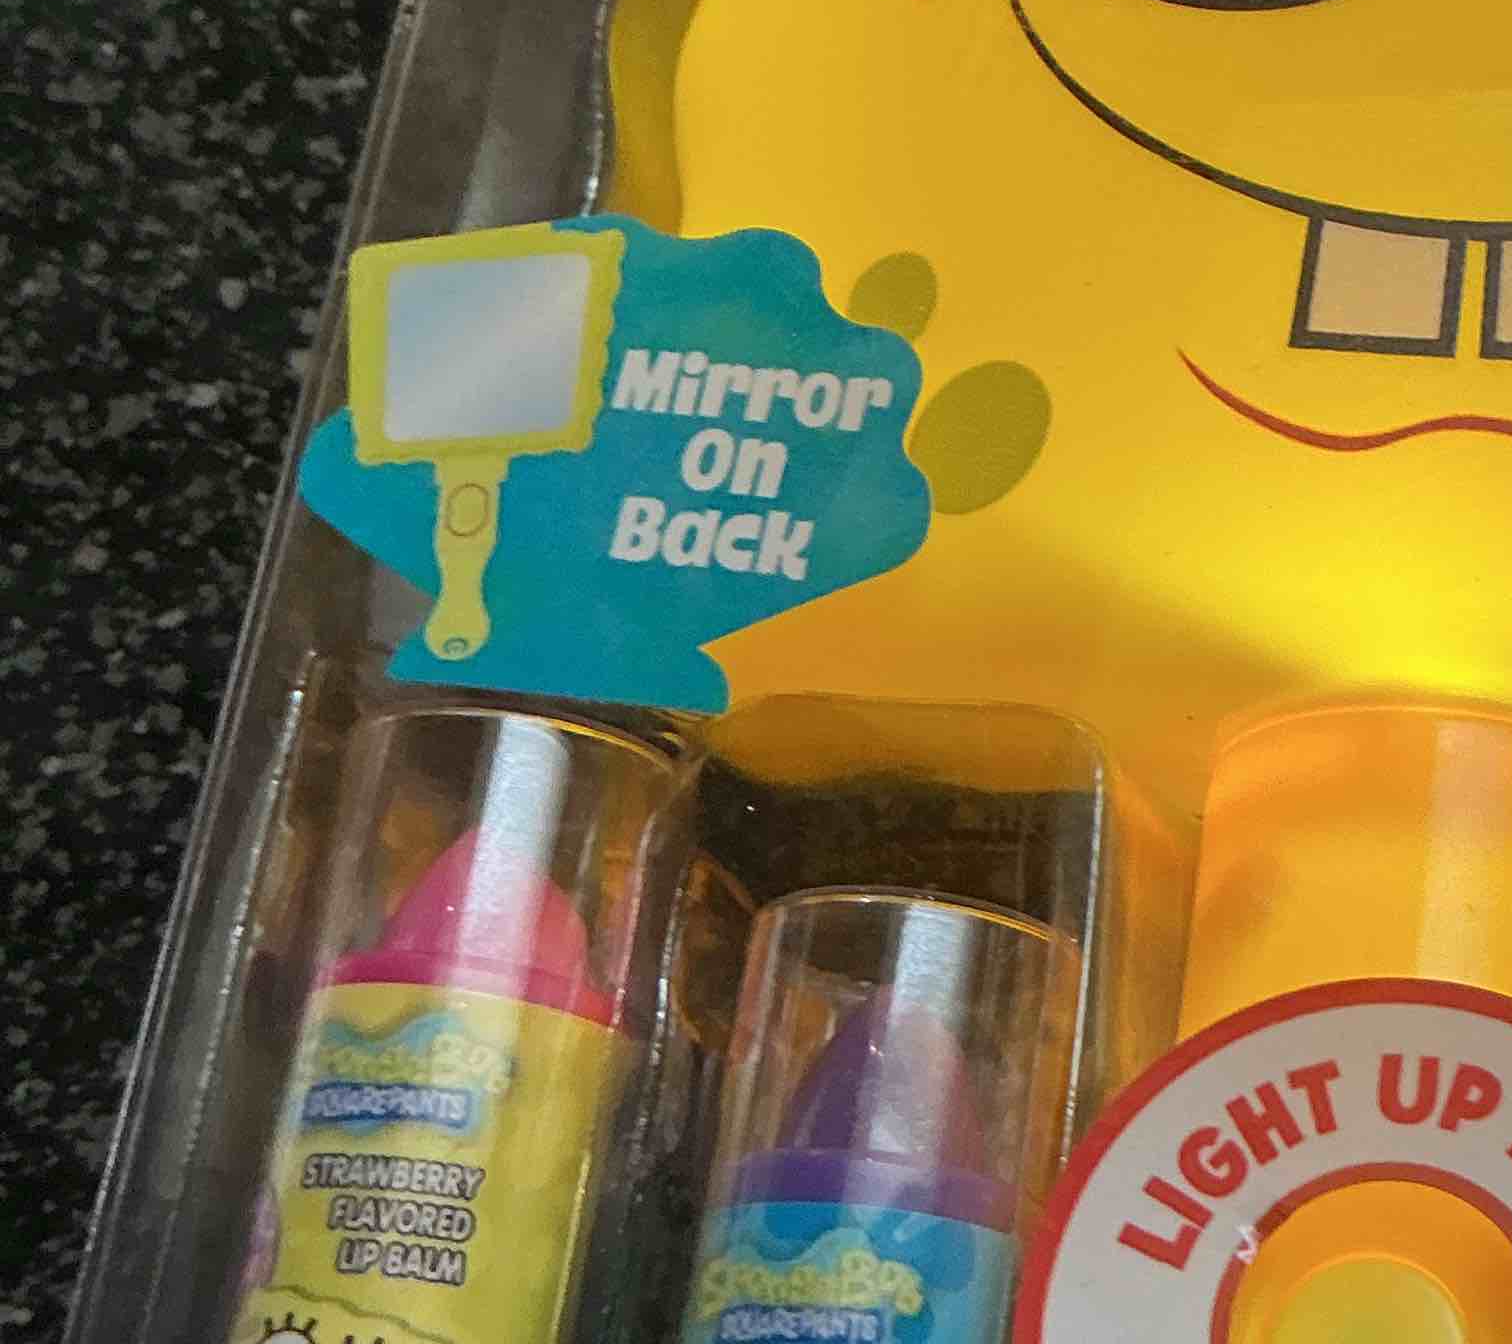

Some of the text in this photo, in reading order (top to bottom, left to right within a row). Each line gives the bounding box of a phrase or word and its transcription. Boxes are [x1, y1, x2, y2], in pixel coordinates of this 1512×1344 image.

[610, 347, 894, 432] Mirror
[681, 428, 788, 497] On
[608, 495, 814, 580] Back
[301, 1153, 485, 1200] STRAWBERRY
[1117, 1060, 1340, 1271] LIGHT
[1377, 1053, 1503, 1133] UP
[327, 1194, 476, 1242] FLAVORED
[334, 1237, 467, 1287] LIP BALM
